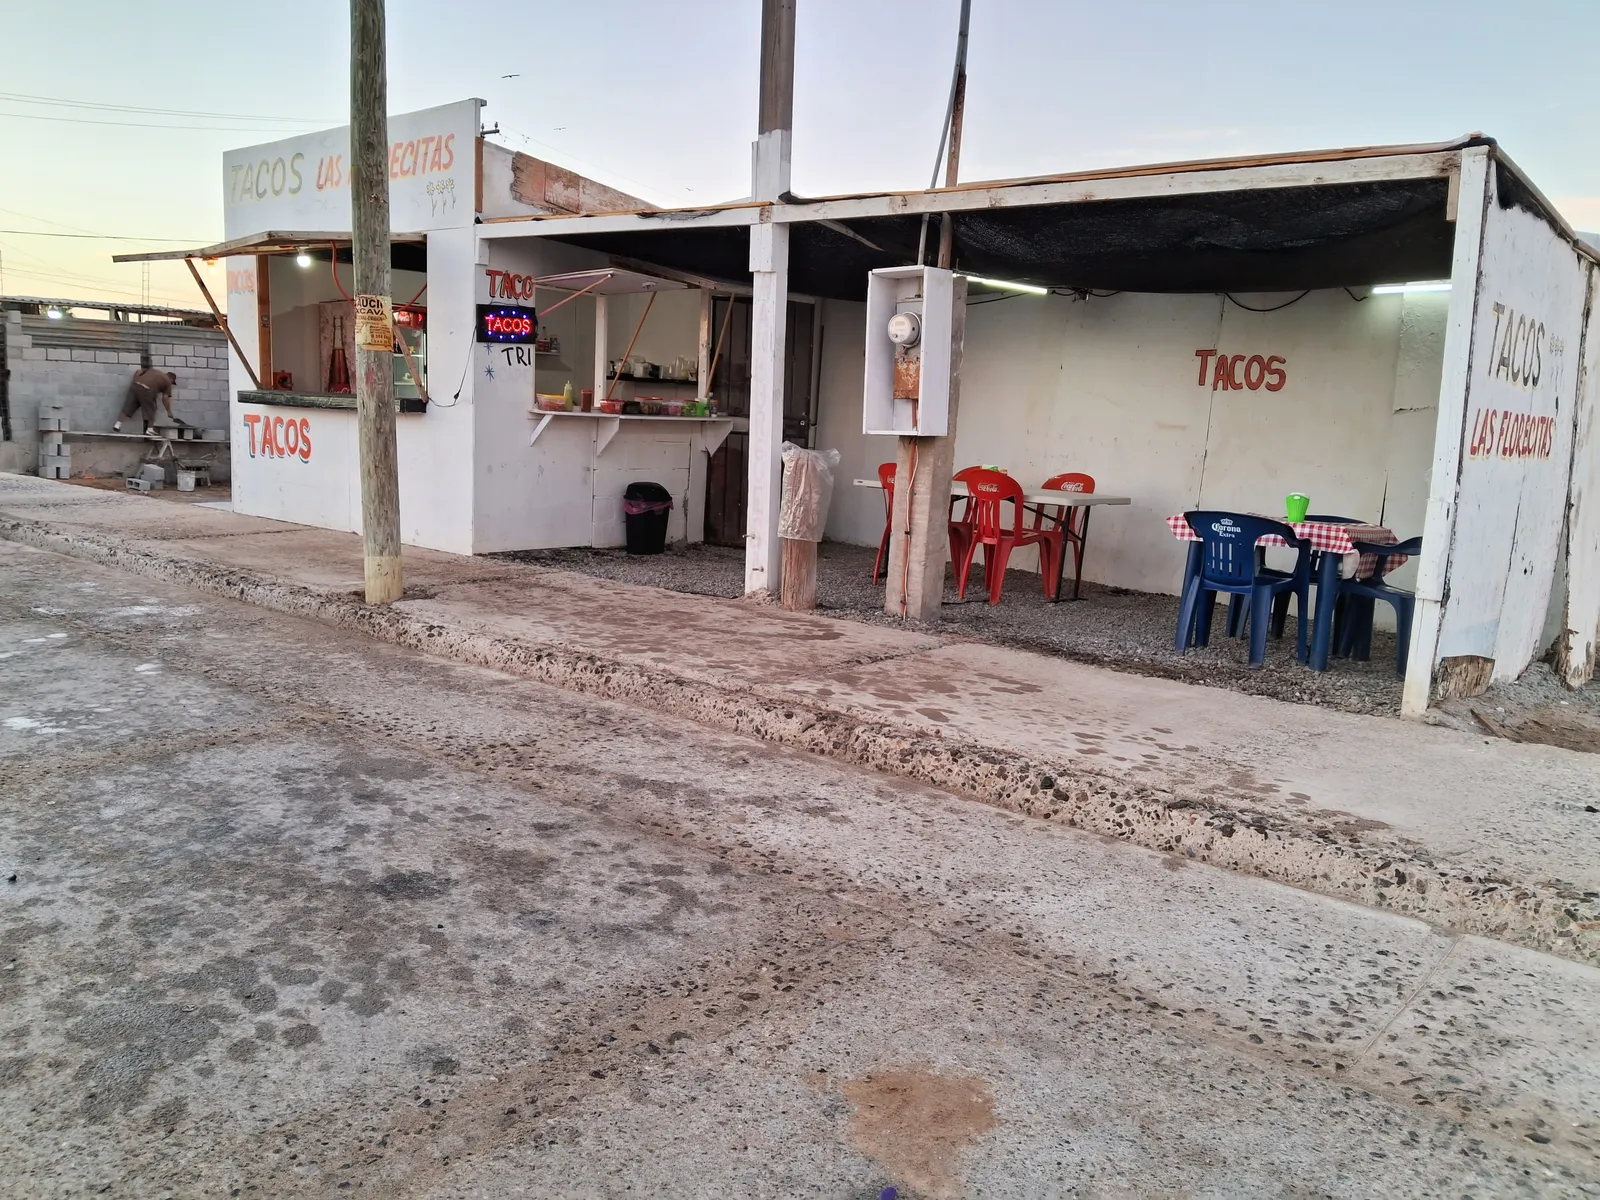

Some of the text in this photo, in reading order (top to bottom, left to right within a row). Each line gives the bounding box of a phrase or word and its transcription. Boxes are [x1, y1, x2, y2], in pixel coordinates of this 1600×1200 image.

[229, 151, 304, 203] TACOS
[316, 155, 343, 190] LAS
[484, 268, 535, 301] TACO
[484, 315, 532, 333] TACOS
[1489, 301, 1545, 387] TACOS
[501, 346, 532, 367] TRI
[1195, 349, 1287, 392] TACOS
[244, 414, 312, 464] TACOS
[1470, 408, 1554, 459] LAS FLORECITAS
[1211, 522, 1242, 533] Corona
